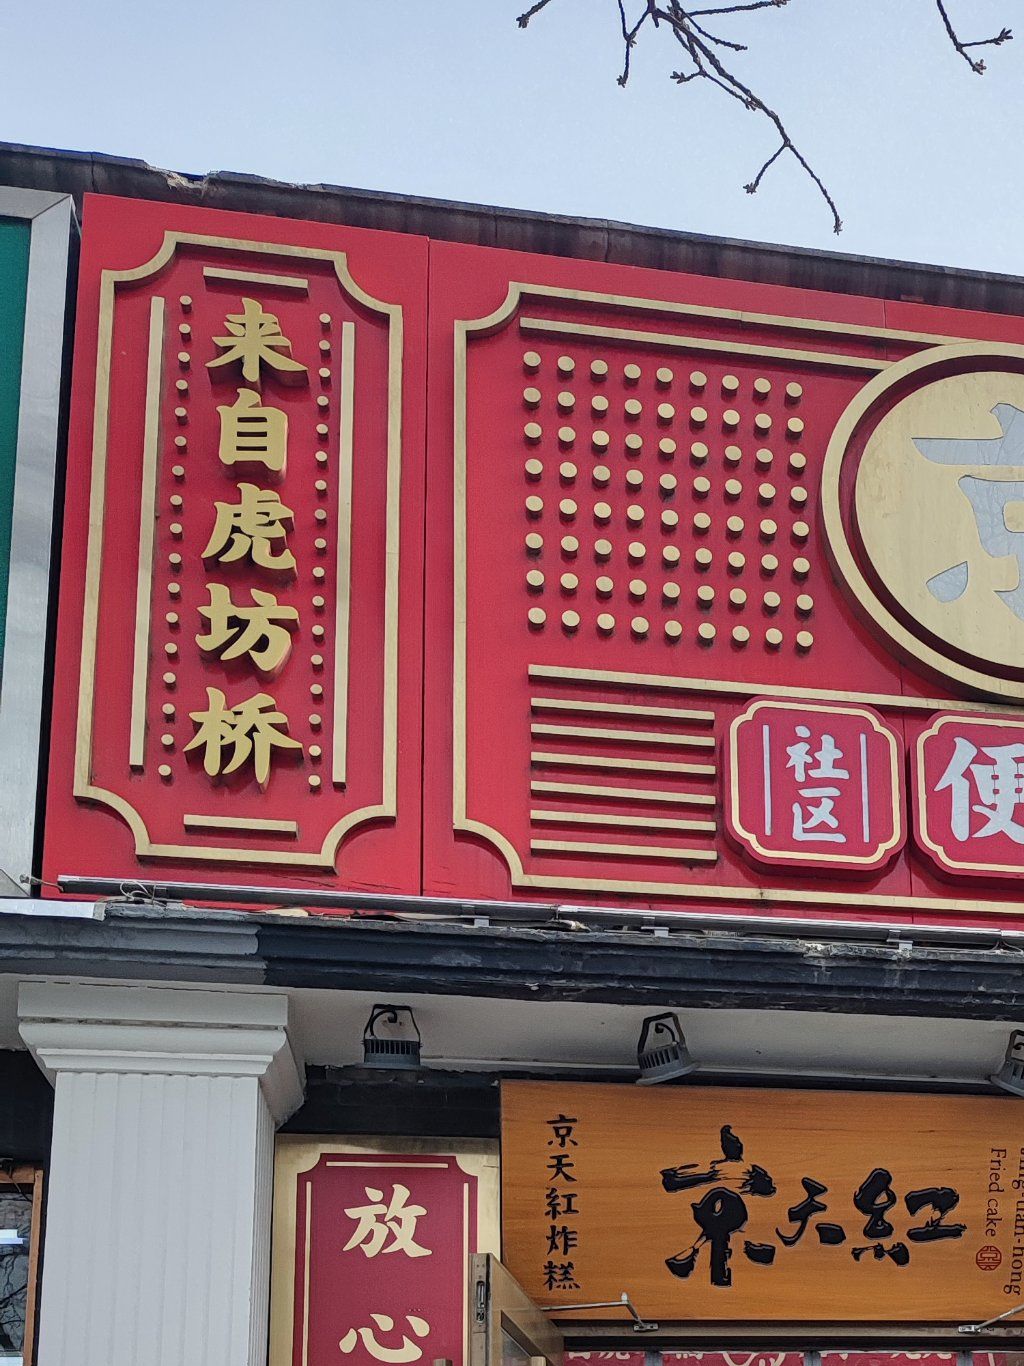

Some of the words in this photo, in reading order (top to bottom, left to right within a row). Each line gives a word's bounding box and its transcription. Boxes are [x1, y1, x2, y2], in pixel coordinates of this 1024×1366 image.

[183, 297, 308, 784] 来自虎坊桥
[786, 726, 850, 843] 社区
[989, 1148, 1007, 1193] Fried
[986, 1198, 1002, 1237] cake
